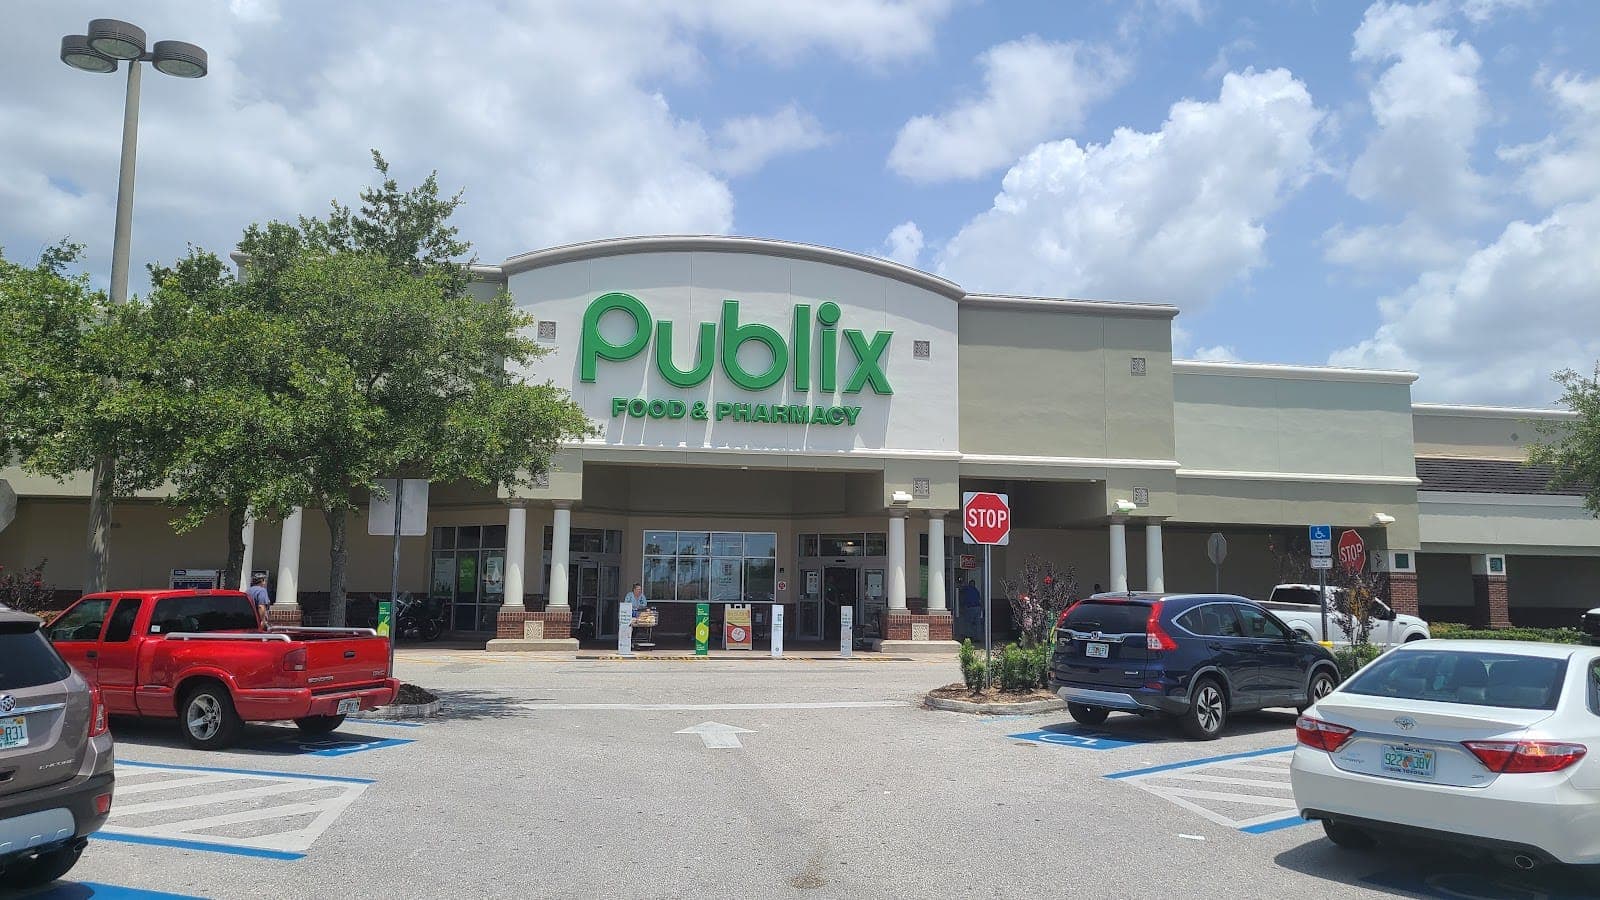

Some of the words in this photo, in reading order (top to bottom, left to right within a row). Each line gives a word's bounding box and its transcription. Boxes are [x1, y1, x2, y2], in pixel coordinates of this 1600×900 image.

[580, 291, 895, 396] Publix
[612, 397, 687, 419] FOOD
[691, 400, 709, 421] &
[716, 401, 862, 426] PHARMACY
[967, 508, 1007, 529] STOP
[1340, 543, 1363, 562] STOP
[1384, 752, 1403, 767] 922
